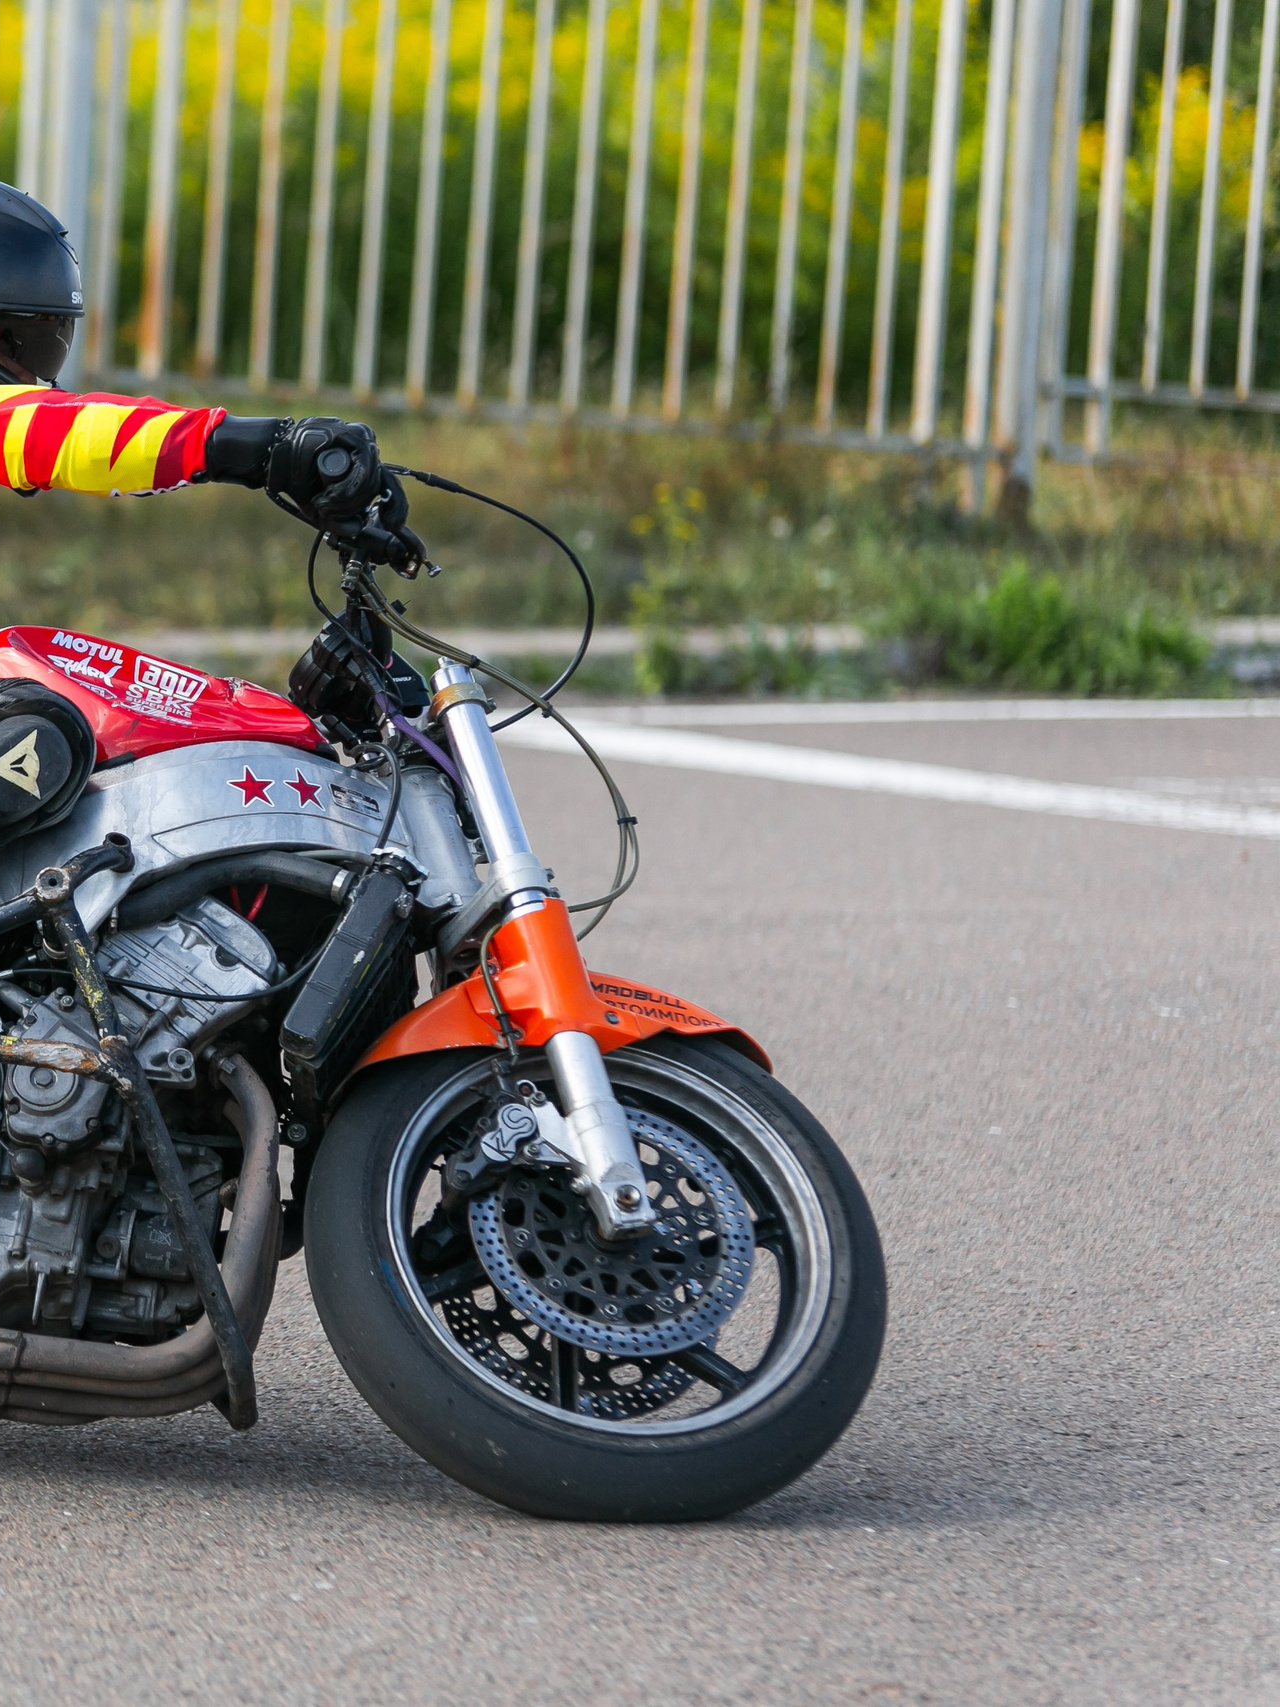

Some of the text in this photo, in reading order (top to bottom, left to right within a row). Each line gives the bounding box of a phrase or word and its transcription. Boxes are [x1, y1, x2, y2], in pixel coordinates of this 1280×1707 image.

[51, 631, 124, 664] MOTUL
[47, 654, 122, 688] SHARK
[125, 696, 193, 719] SUPERBIKE
[589, 981, 688, 1010] MADBULL
[604, 999, 723, 1028] ВТОИМПОРТ
